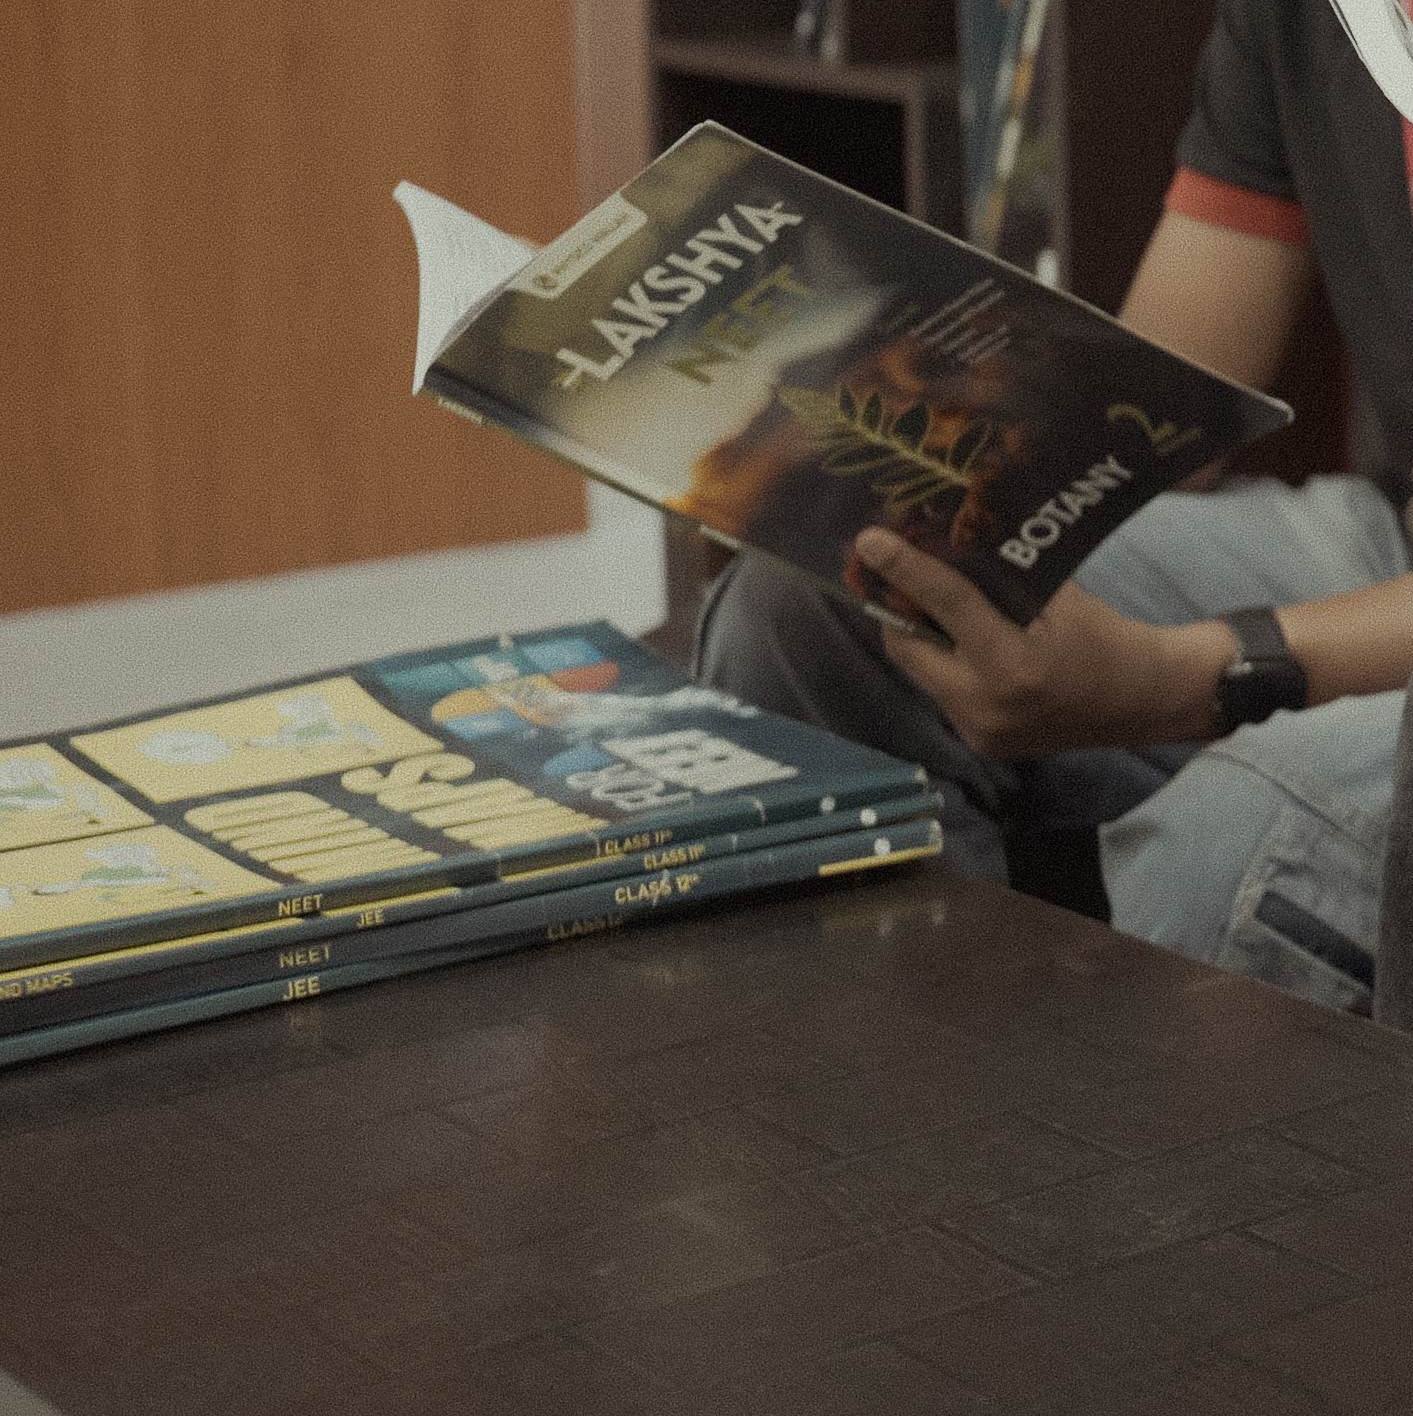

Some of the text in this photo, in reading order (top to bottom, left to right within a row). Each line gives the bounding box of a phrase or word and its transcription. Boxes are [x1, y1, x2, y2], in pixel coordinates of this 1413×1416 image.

[557, 200, 804, 381] LAKSHYA
[669, 263, 816, 385] NEET
[1001, 455, 1134, 570] BOTANY
[278, 894, 324, 918] NEET
[605, 834, 650, 854] CLASS
[356, 909, 386, 927] JEE
[643, 848, 687, 870] CLASS
[280, 945, 332, 970] NEET
[614, 879, 672, 904] CLASS
[282, 978, 322, 1001] JEE
